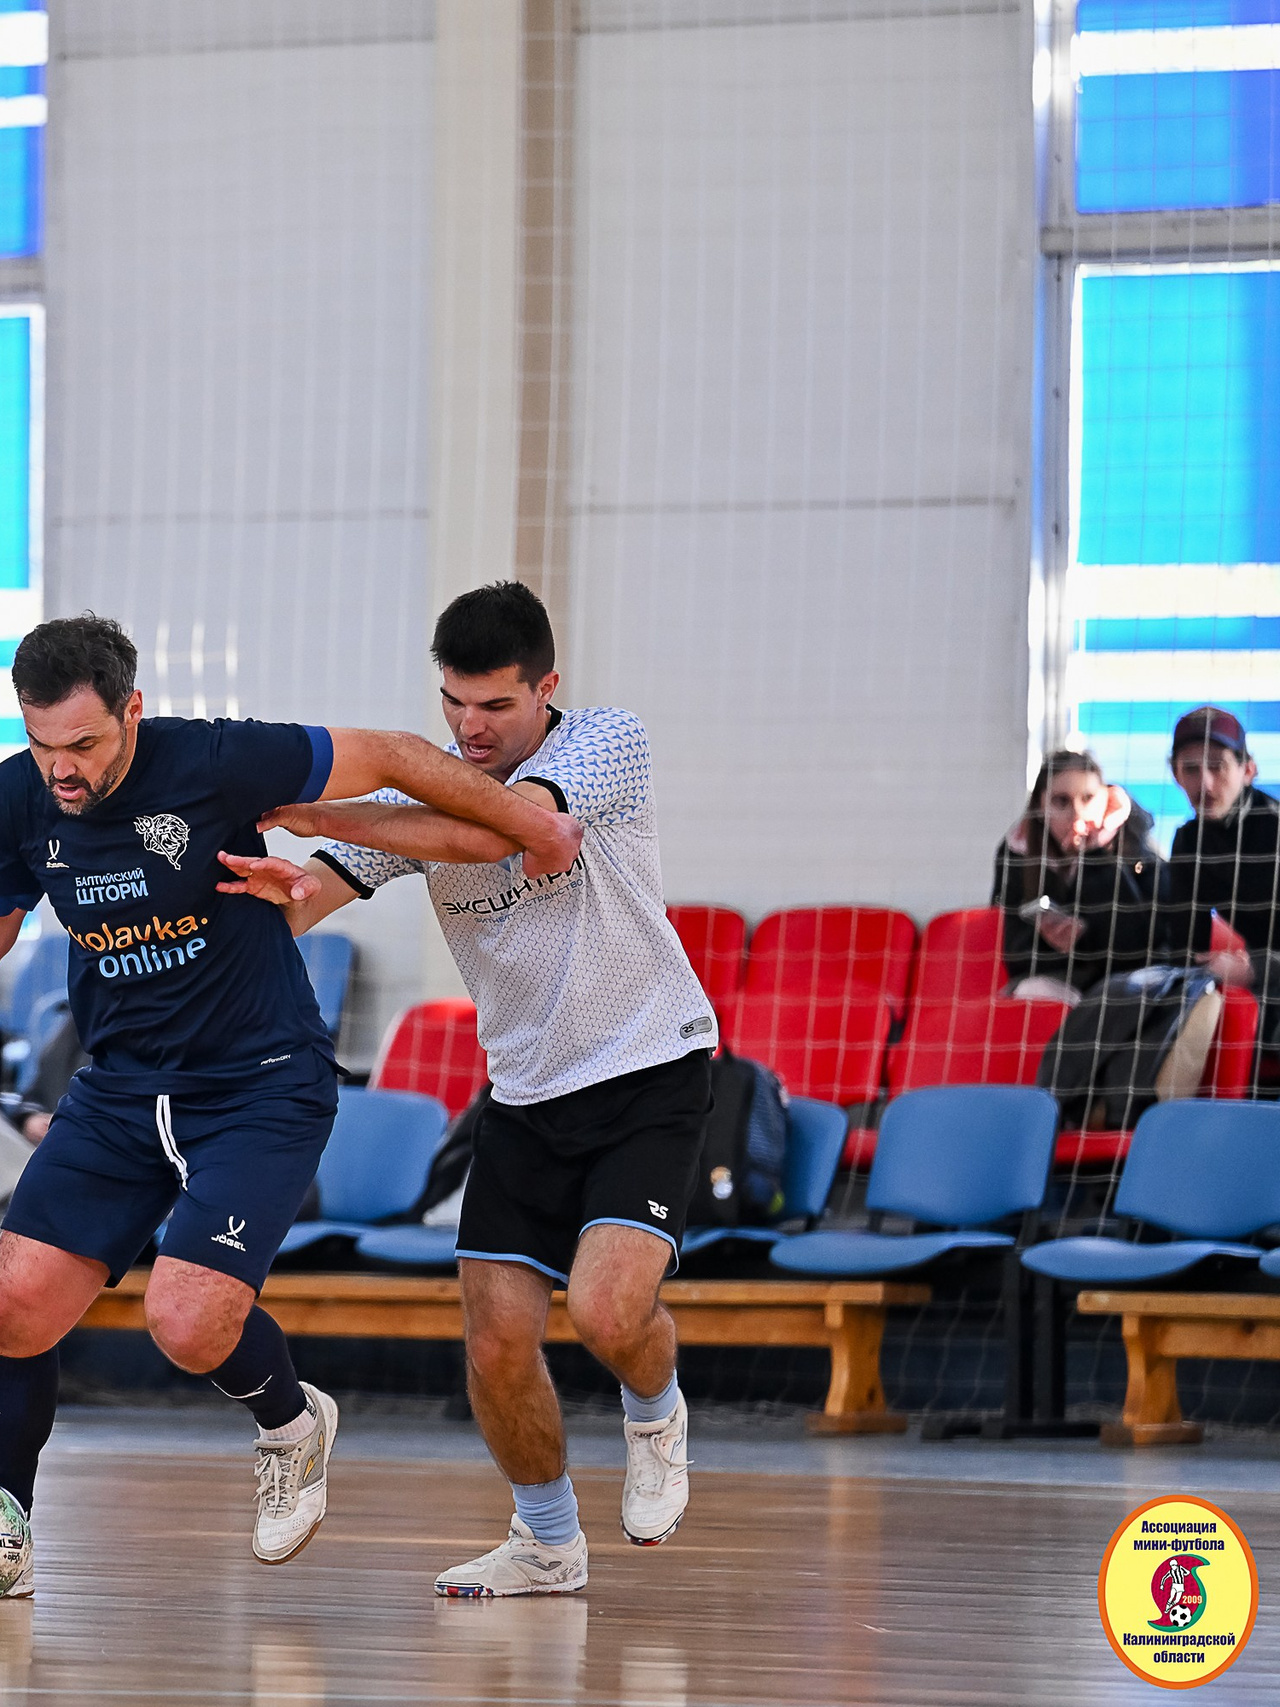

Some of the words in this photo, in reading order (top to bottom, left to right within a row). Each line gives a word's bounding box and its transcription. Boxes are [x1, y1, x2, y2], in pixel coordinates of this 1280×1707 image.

[75, 867, 145, 887] БАЛТИЙСКИЙ
[76, 880, 149, 905] ШТОРМ
[99, 937, 207, 978] online
